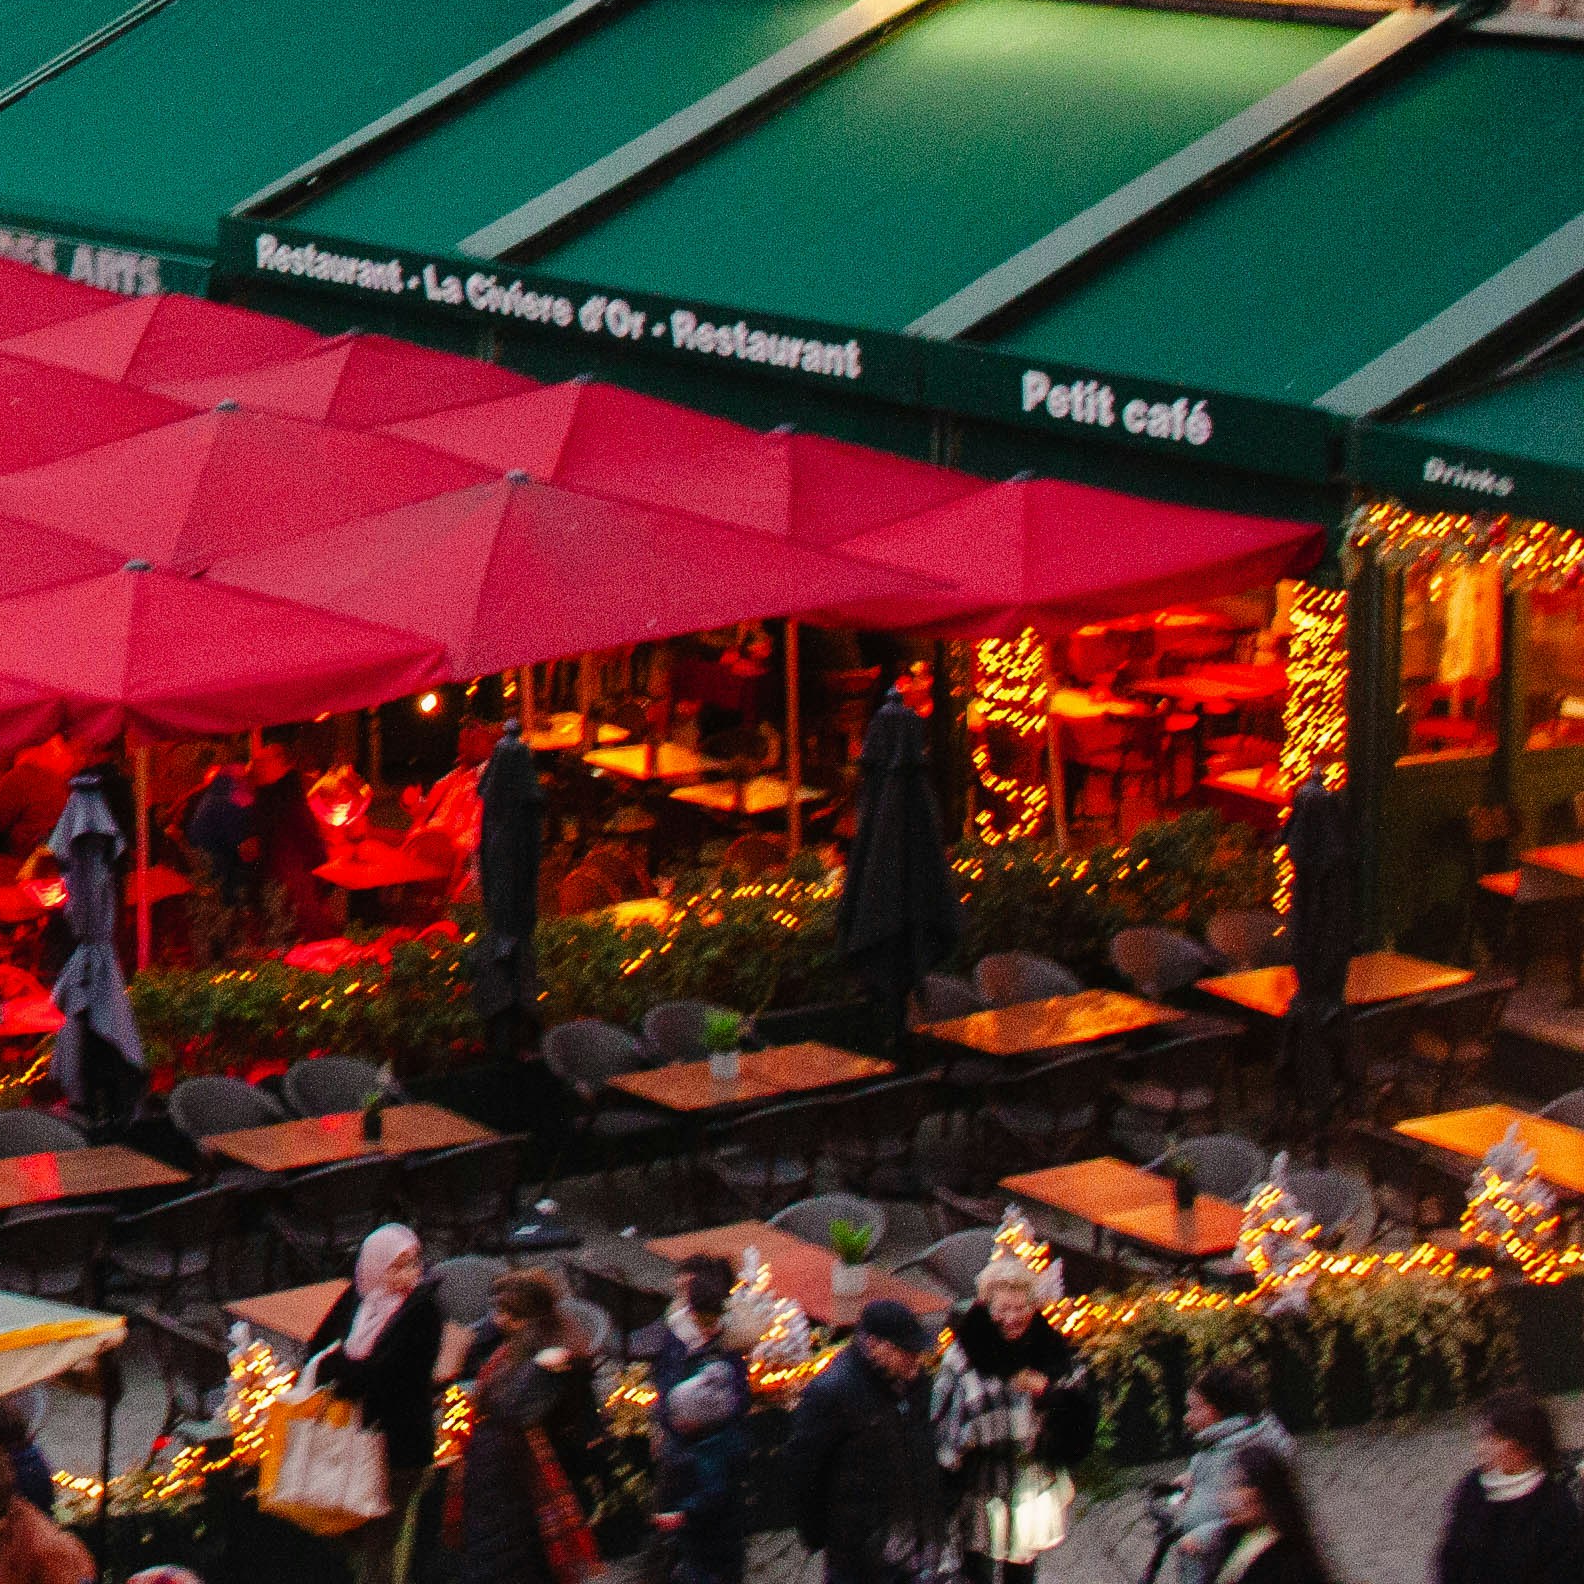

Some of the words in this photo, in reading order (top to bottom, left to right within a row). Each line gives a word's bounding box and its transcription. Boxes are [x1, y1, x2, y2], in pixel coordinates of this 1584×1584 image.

[69, 243, 162, 295] ARTS
[255, 233, 405, 295] Restaurant
[422, 263, 464, 305] La
[578, 295, 646, 340] d'Or
[670, 309, 863, 380] Restaurant
[1021, 368, 1116, 428] Petit
[1122, 396, 1213, 447] café
